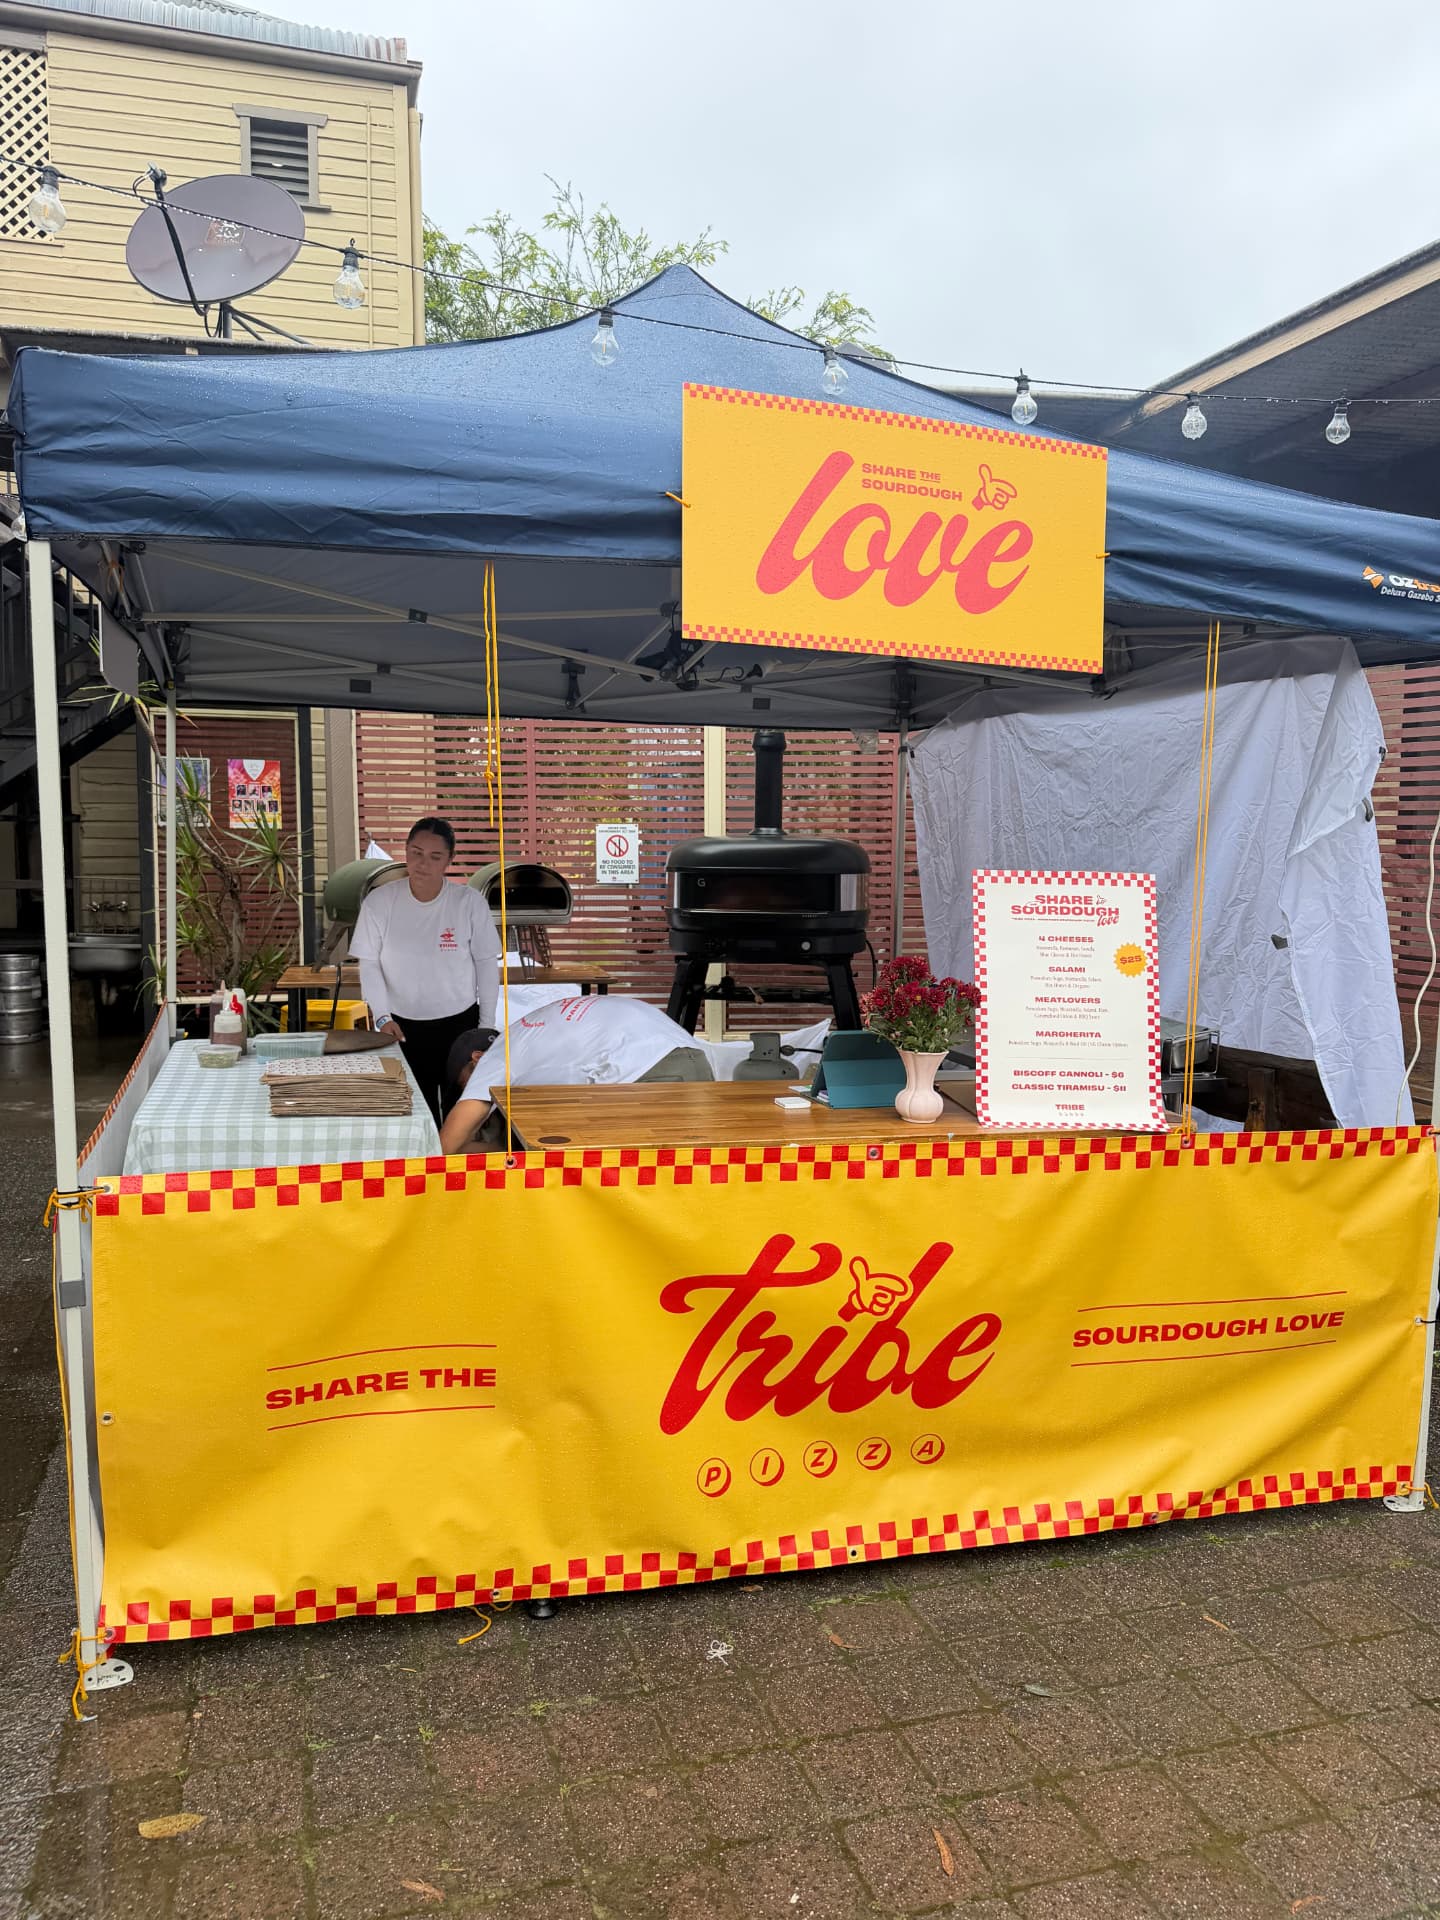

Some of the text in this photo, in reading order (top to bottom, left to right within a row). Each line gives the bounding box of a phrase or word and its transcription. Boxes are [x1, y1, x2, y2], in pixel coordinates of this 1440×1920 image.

[862, 463, 941, 480] SHARE THE
[862, 479, 963, 501] SOURDOUGH
[756, 450, 1034, 615] love
[1380, 586, 1406, 597] Deluxe
[1408, 591, 1434, 602] Gazebo
[1035, 895, 1093, 905] SHARE
[1011, 905, 1119, 916] SOURDOUGH
[1097, 911, 1119, 927] love
[1120, 956, 1142, 964] $25
[1073, 1311, 1345, 1348] SOURDOUGH LOVE
[266, 1368, 496, 1410] SHARE THE
